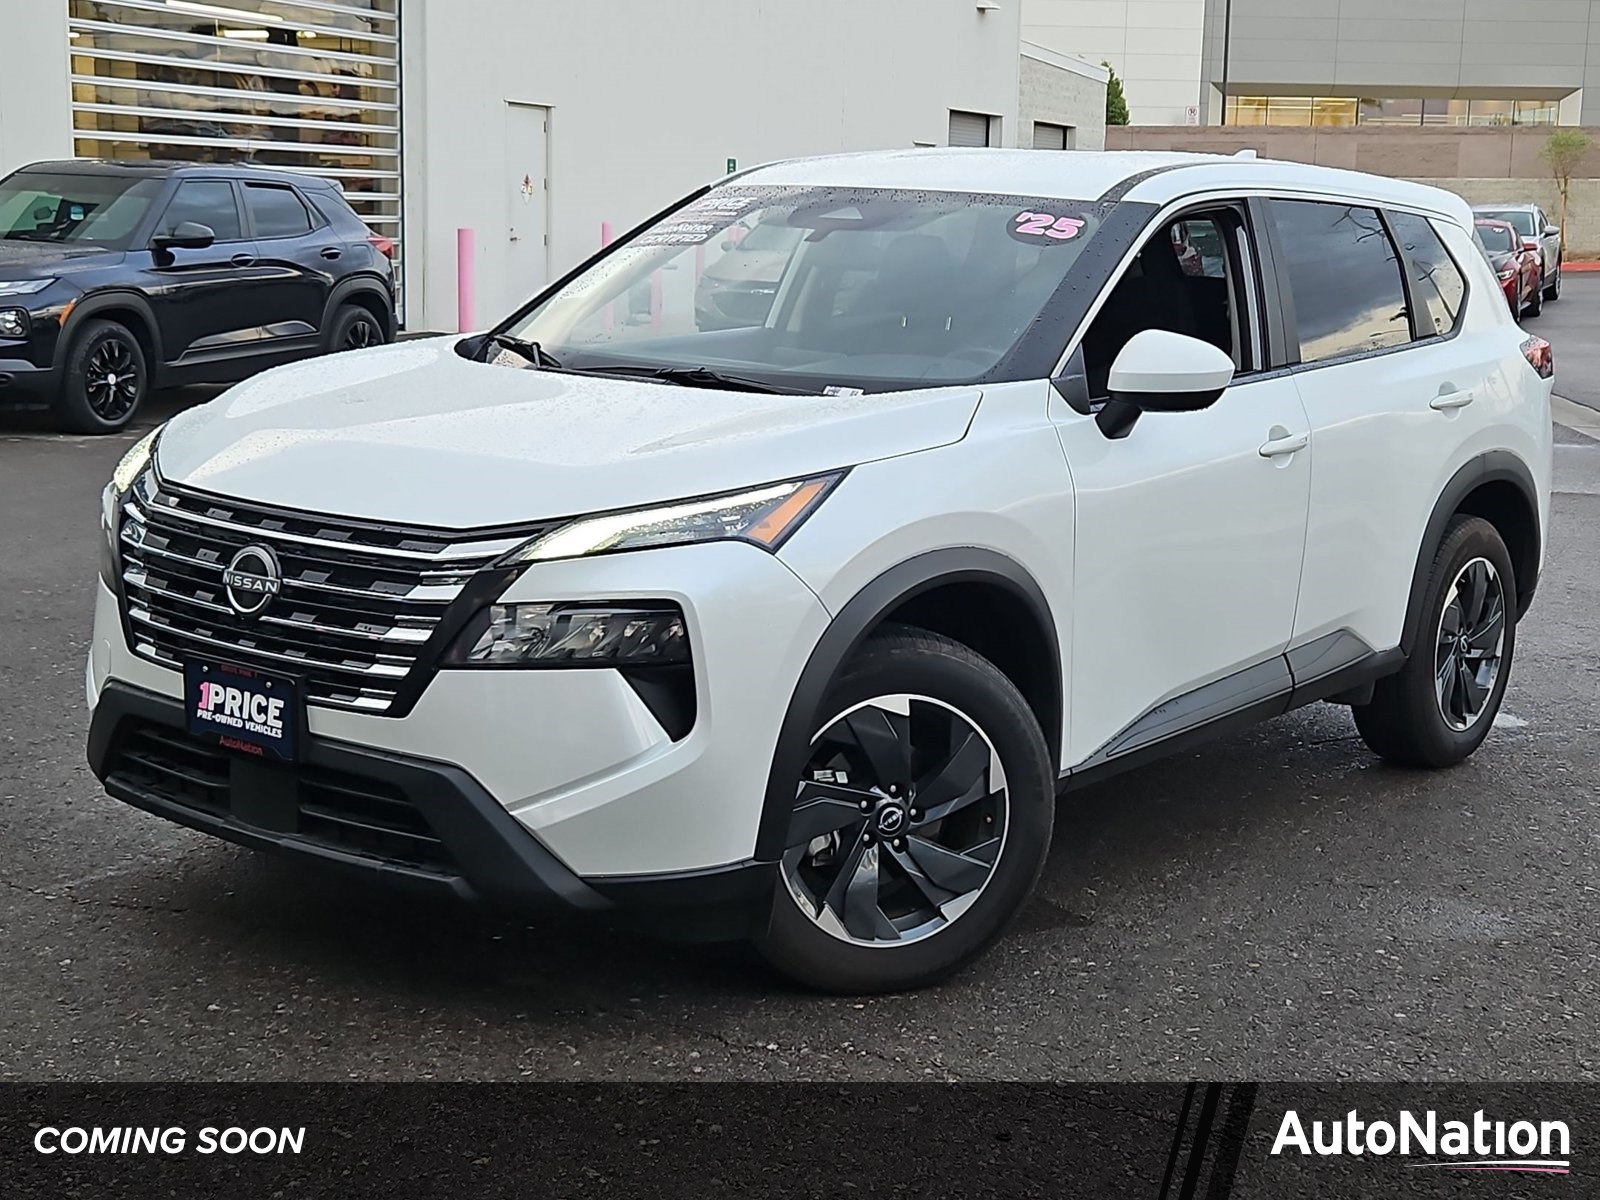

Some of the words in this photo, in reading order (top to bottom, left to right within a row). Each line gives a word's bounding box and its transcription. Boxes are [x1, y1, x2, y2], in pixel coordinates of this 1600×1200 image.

[1015, 211, 1086, 239] '25
[222, 571, 278, 592] NISSAN
[197, 708, 243, 728] PRE-OWNED
[244, 720, 283, 738] VEHICLES
